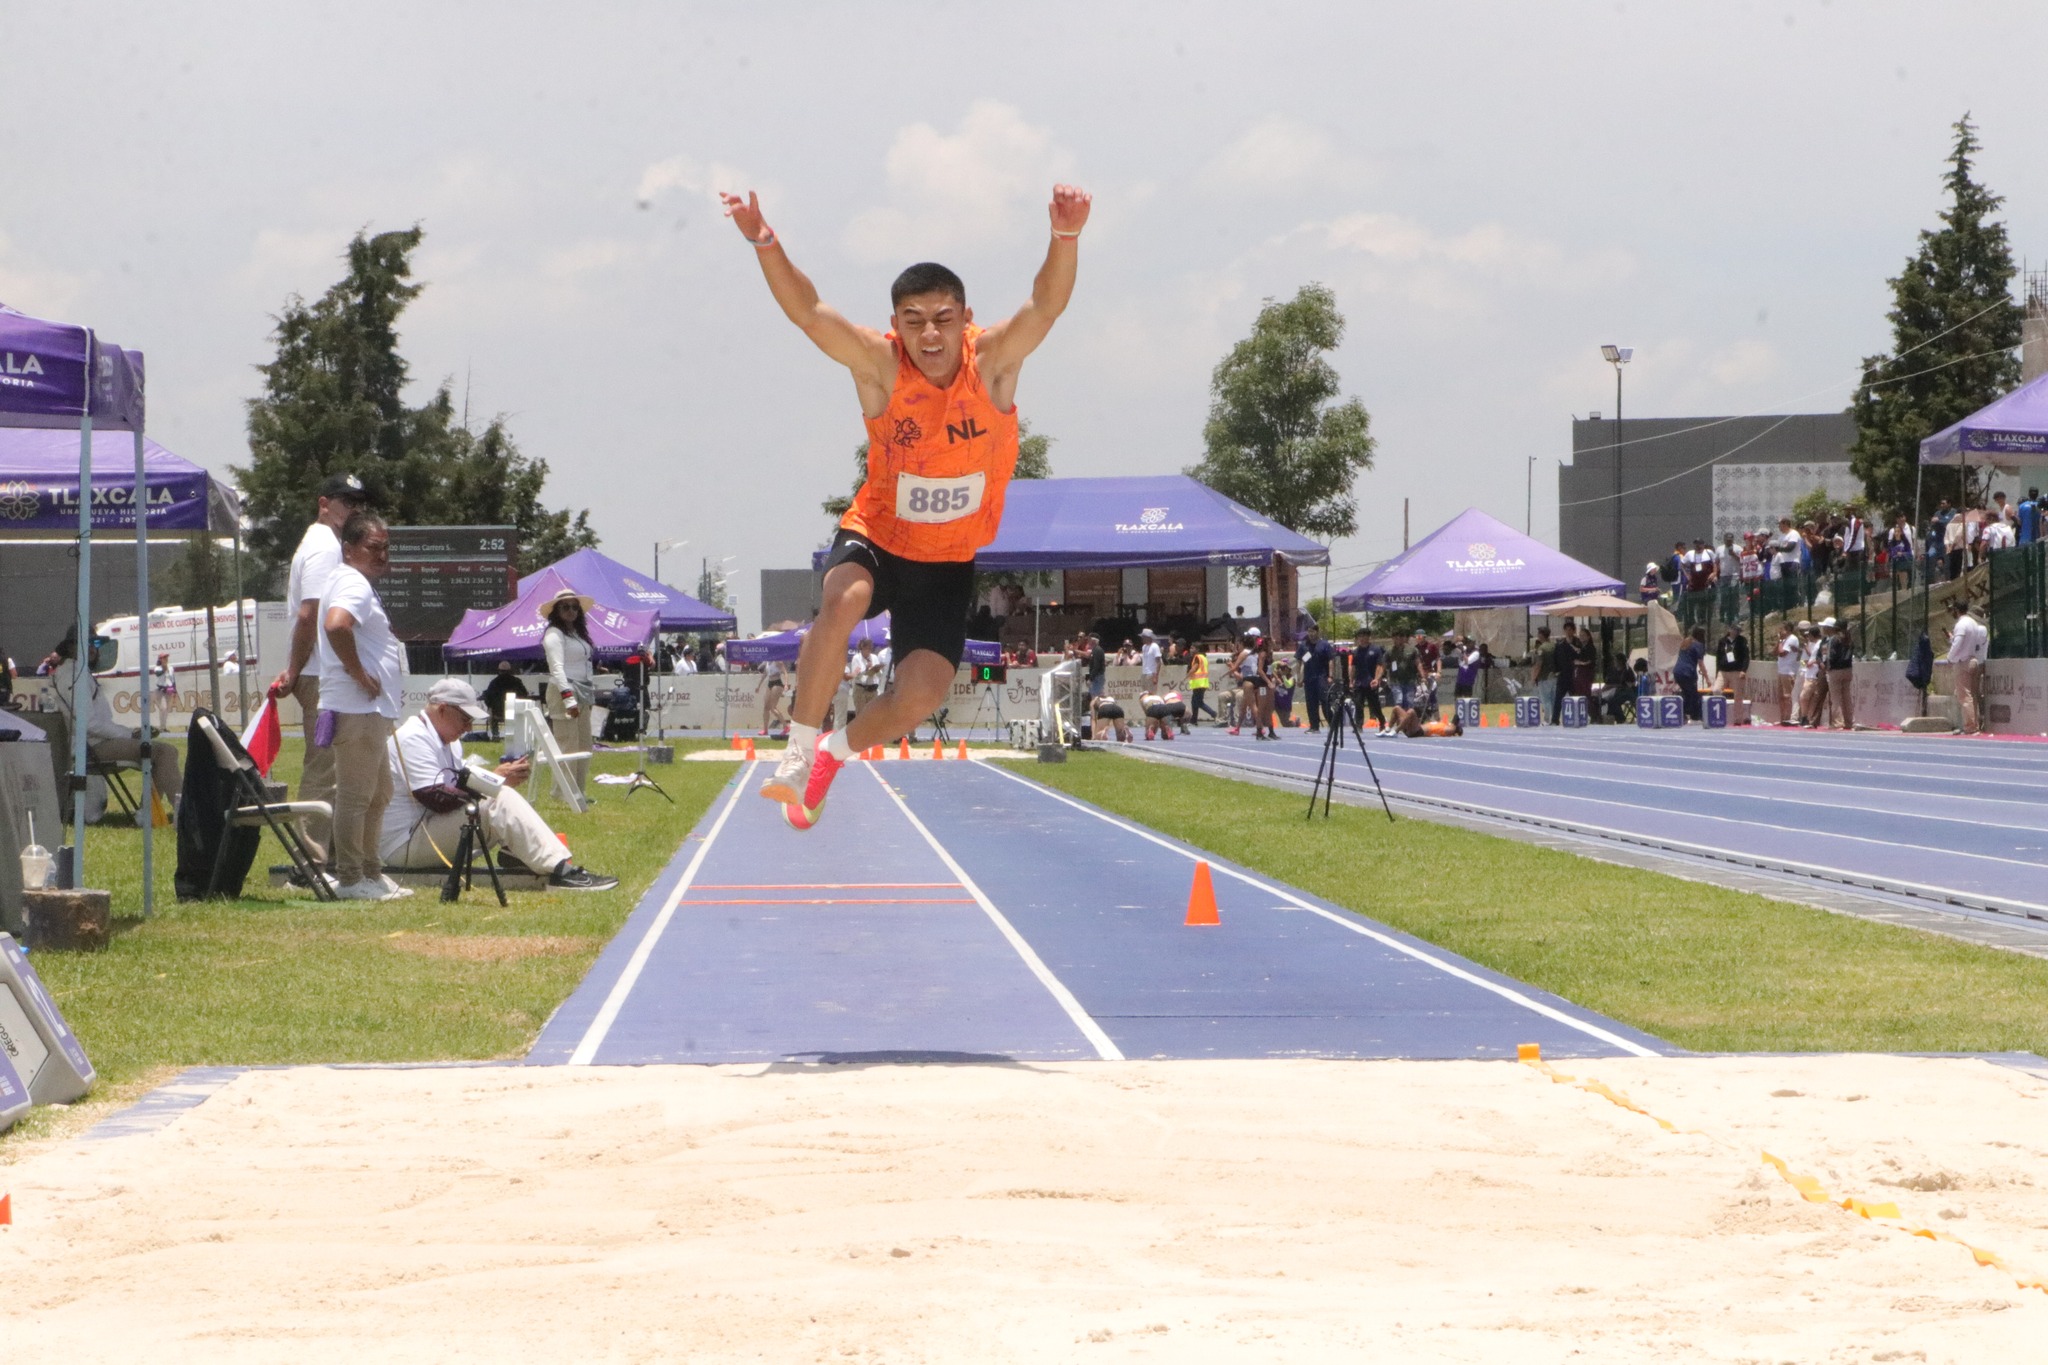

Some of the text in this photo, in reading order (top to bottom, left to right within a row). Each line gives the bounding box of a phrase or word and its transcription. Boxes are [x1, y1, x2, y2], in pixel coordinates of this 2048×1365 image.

[0, 352, 44, 375] LA
[946, 417, 987, 445] NL
[1992, 433, 2046, 444] TLAXCALA
[48, 487, 175, 505] TLXCALA
[908, 486, 970, 514] 885
[1115, 522, 1184, 531] TLAXCALA
[480, 538, 506, 551] 2:52
[1445, 558, 1527, 569] TLAXCALA
[151, 641, 186, 651] SALUD
[597, 645, 633, 653] TLAXCALA
[1179, 681, 1220, 691] CODE
[225, 690, 264, 713] 202
[676, 691, 691, 703] paz
[715, 689, 754, 702] Saudable
[1457, 705, 1464, 719] 6
[1470, 705, 1478, 720] 6
[1517, 705, 1523, 719] 5
[1530, 705, 1538, 720] 5
[1564, 704, 1572, 719] 4
[1579, 705, 1586, 719] 4
[1641, 702, 1651, 718] 3
[1665, 702, 1678, 719] 2
[1712, 702, 1721, 719] 1
